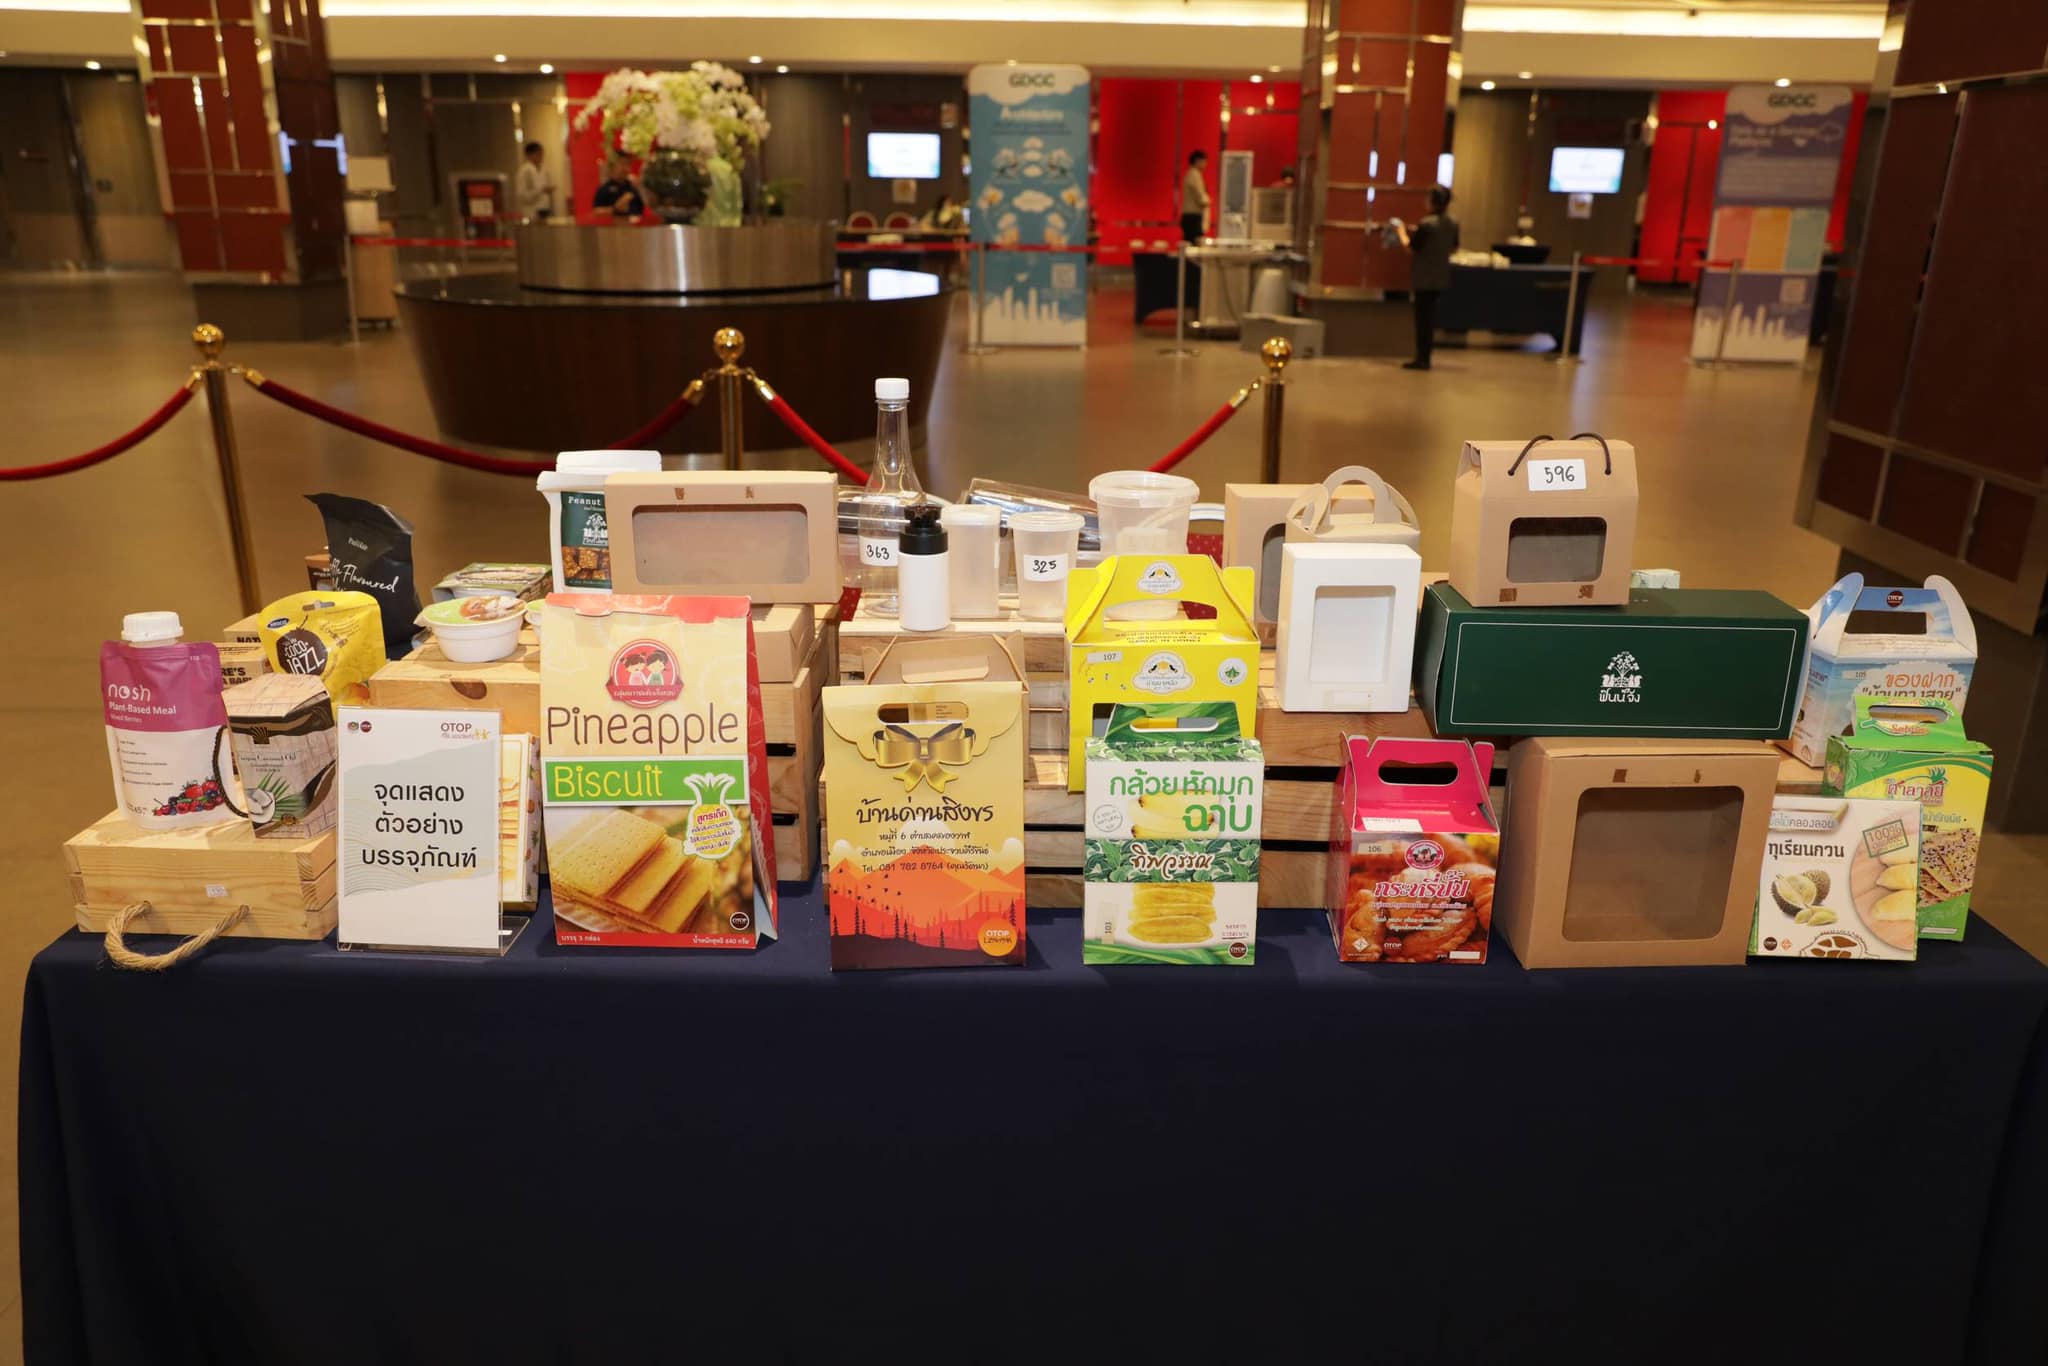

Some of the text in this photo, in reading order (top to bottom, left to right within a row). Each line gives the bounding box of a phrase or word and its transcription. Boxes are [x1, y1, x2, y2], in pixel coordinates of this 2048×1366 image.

[1010, 74, 1055, 88] GDCC
[1544, 465, 1575, 484] 596
[568, 496, 601, 506] Peanut
[866, 544, 890, 560] 363
[1032, 559, 1057, 573] 325
[1886, 672, 1955, 688] ของฝาก
[108, 683, 151, 702] nosh
[152, 705, 177, 715] Meal
[441, 722, 472, 732] OTOP
[547, 702, 739, 755] Pineapple
[554, 764, 663, 798] Biscuit
[1110, 769, 1254, 803] กล้วยหักมุก
[374, 784, 464, 807] จุดแสดง
[856, 795, 994, 823] บ้านด่านสิงขร
[1182, 804, 1253, 832] ฉาบ
[375, 810, 463, 835] ตัวอย่าง
[900, 832, 907, 840] 6
[1867, 822, 1902, 843] 100%
[1768, 839, 1845, 859] ทุเรียนกวน
[362, 845, 477, 873] บรรจุภัณฑ์
[879, 862, 896, 872] 081
[900, 862, 918, 871] 782
